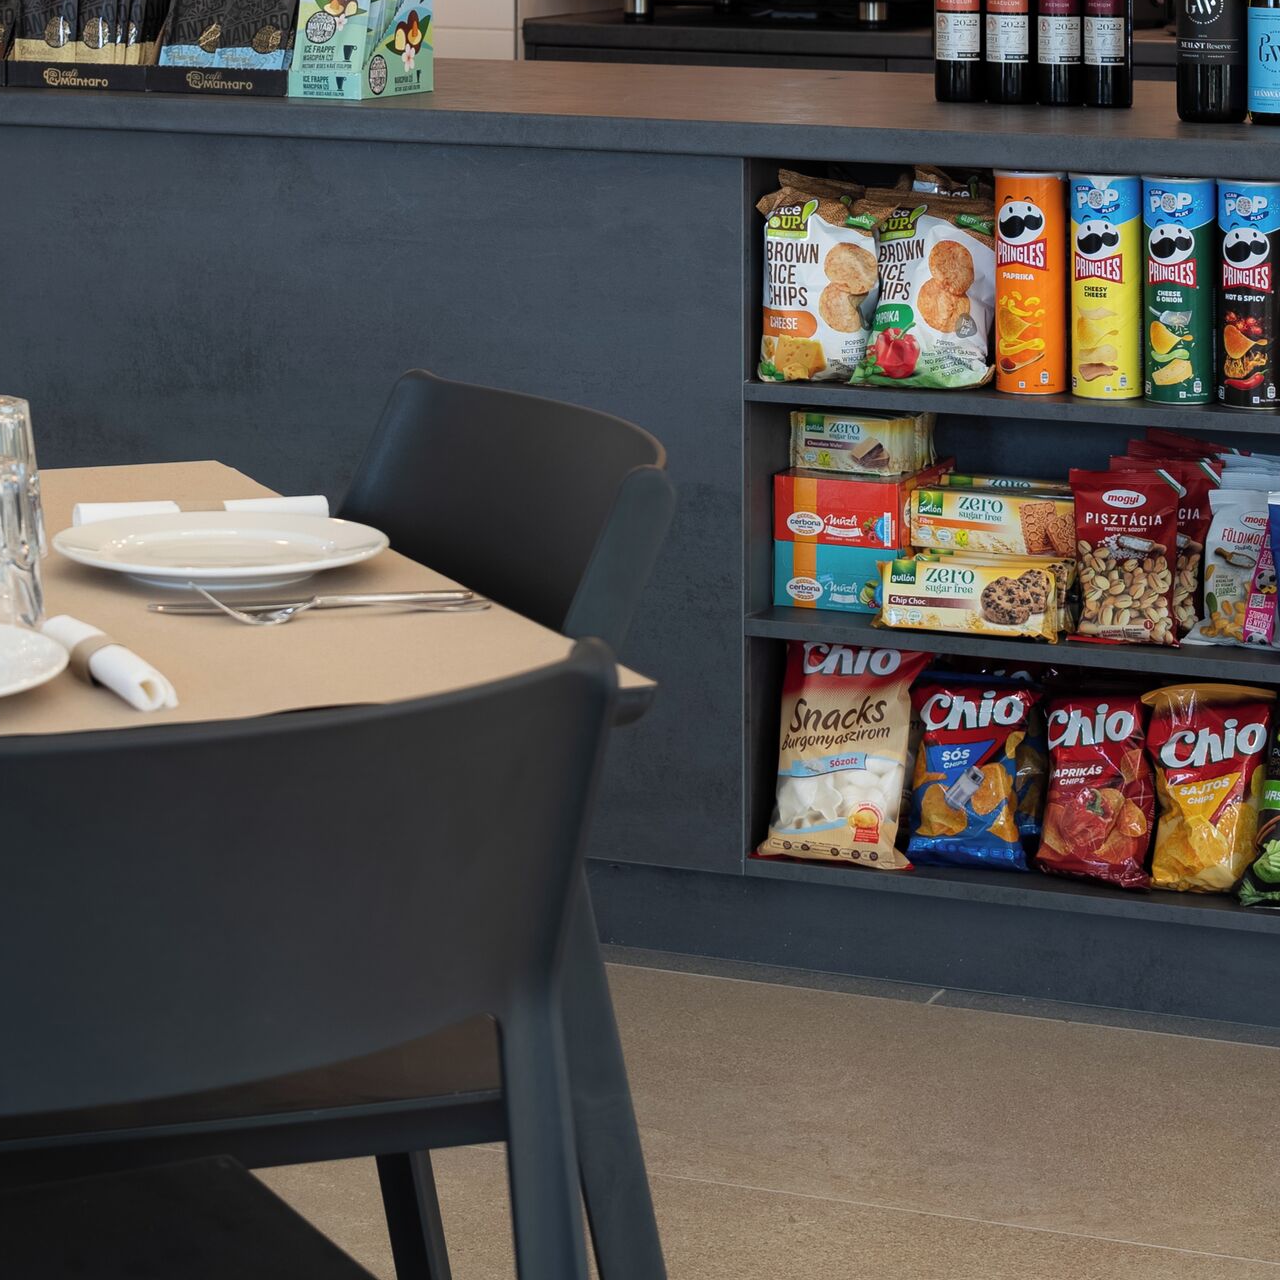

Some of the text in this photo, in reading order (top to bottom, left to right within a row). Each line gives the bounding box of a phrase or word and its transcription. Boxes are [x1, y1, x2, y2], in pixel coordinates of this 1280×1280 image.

[953, 19, 978, 27] 2022
[1001, 21, 1026, 29] 2022
[1055, 23, 1079, 31] 2022
[1097, 23, 1122, 31] 2022
[61, 77, 108, 87] Mantaro
[204, 80, 253, 90] Mantaro
[766, 241, 819, 264] BROWN
[878, 239, 925, 263] BROWN
[998, 241, 1045, 269] PRINGLES
[1076, 257, 1122, 281] PRINGLES
[1149, 262, 1195, 286] PRINGLES
[1002, 271, 1035, 281] PAPRIKA
[1223, 266, 1269, 290] PRINGLES
[1084, 285, 1108, 293] CHEESY
[1225, 294, 1239, 302] HOT
[1246, 295, 1265, 303] SPICY
[770, 316, 798, 330] CHEESE
[829, 422, 860, 434] zero
[829, 433, 860, 441] sugar free
[959, 496, 1003, 513] zero
[1107, 494, 1140, 505] mogyi
[959, 511, 1002, 522] sugar free
[1086, 511, 1162, 526] PISZTÁCIA
[790, 518, 822, 528] cerbona
[926, 568, 975, 585] zero
[789, 583, 821, 593] cerbona
[926, 584, 973, 595] sugar free
[891, 596, 926, 606] Chip Choc
[803, 642, 902, 676] Chio
[790, 695, 888, 733] Snacks
[920, 690, 1025, 731] Chio
[1048, 703, 1135, 749] Chio
[782, 725, 891, 751] Burgonyaszirom
[1160, 718, 1268, 768] Chio
[942, 748, 971, 763] SÓS
[829, 757, 858, 769] Sózott
[944, 760, 968, 769] CHIPS
[1059, 777, 1085, 786] CHIPS
[1180, 777, 1230, 797] SAJTOS
[1187, 793, 1216, 805] CHIPS
